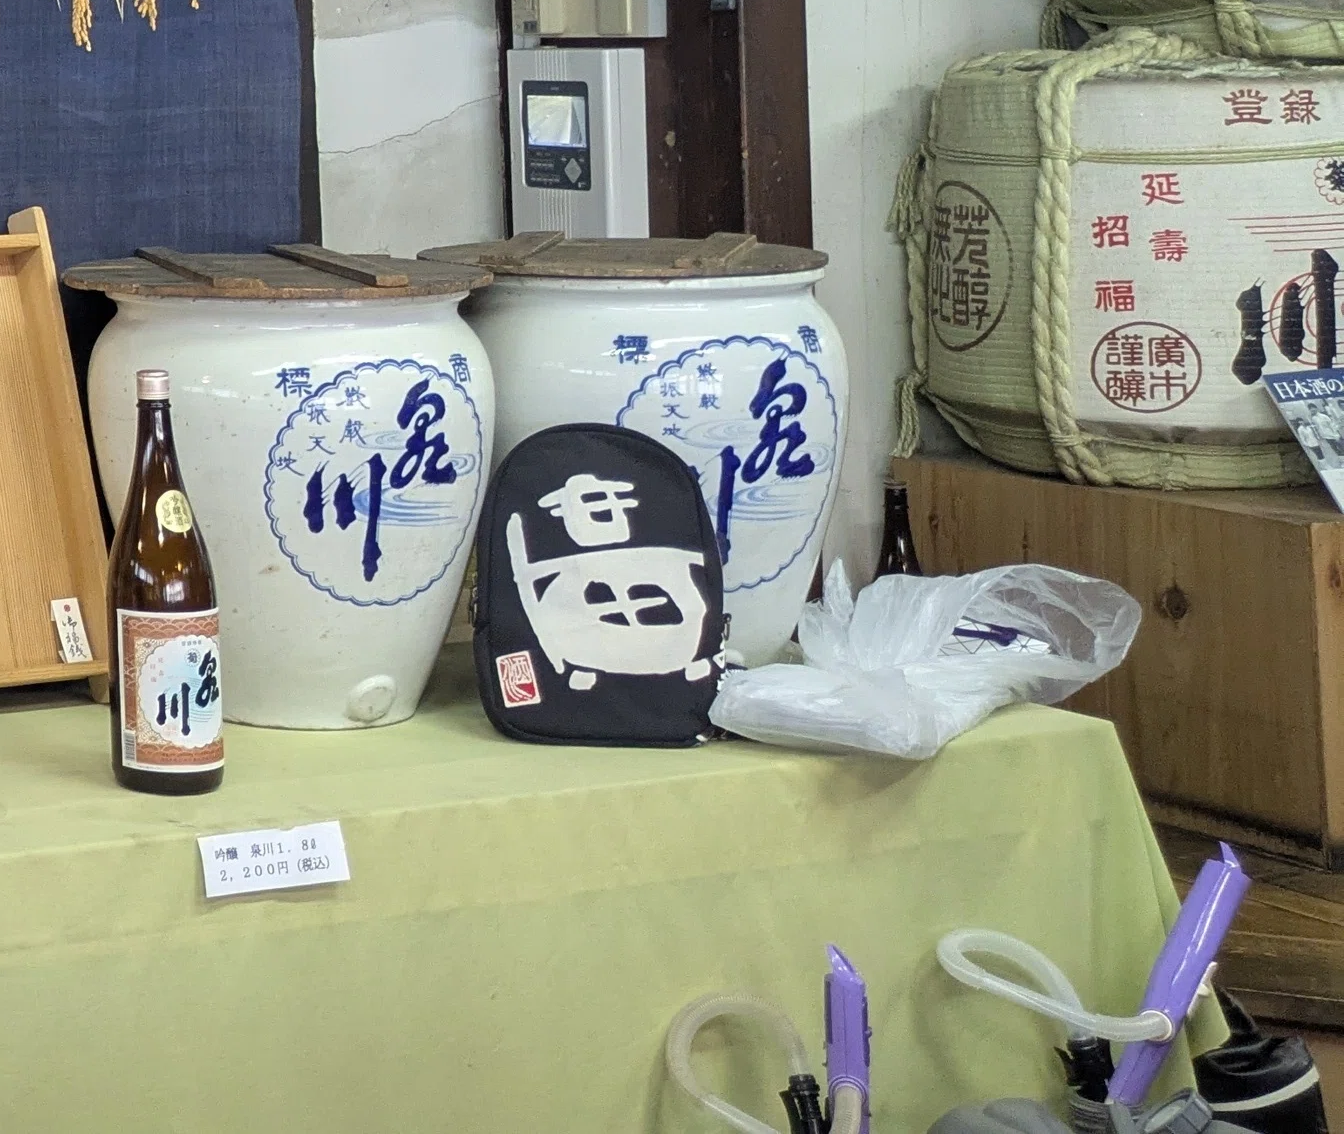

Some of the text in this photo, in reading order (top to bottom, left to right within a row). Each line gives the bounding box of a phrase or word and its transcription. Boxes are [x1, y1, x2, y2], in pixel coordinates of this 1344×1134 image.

[1091, 215, 1136, 313] 招福
[1273, 377, 1344, 402] 日本酒の
